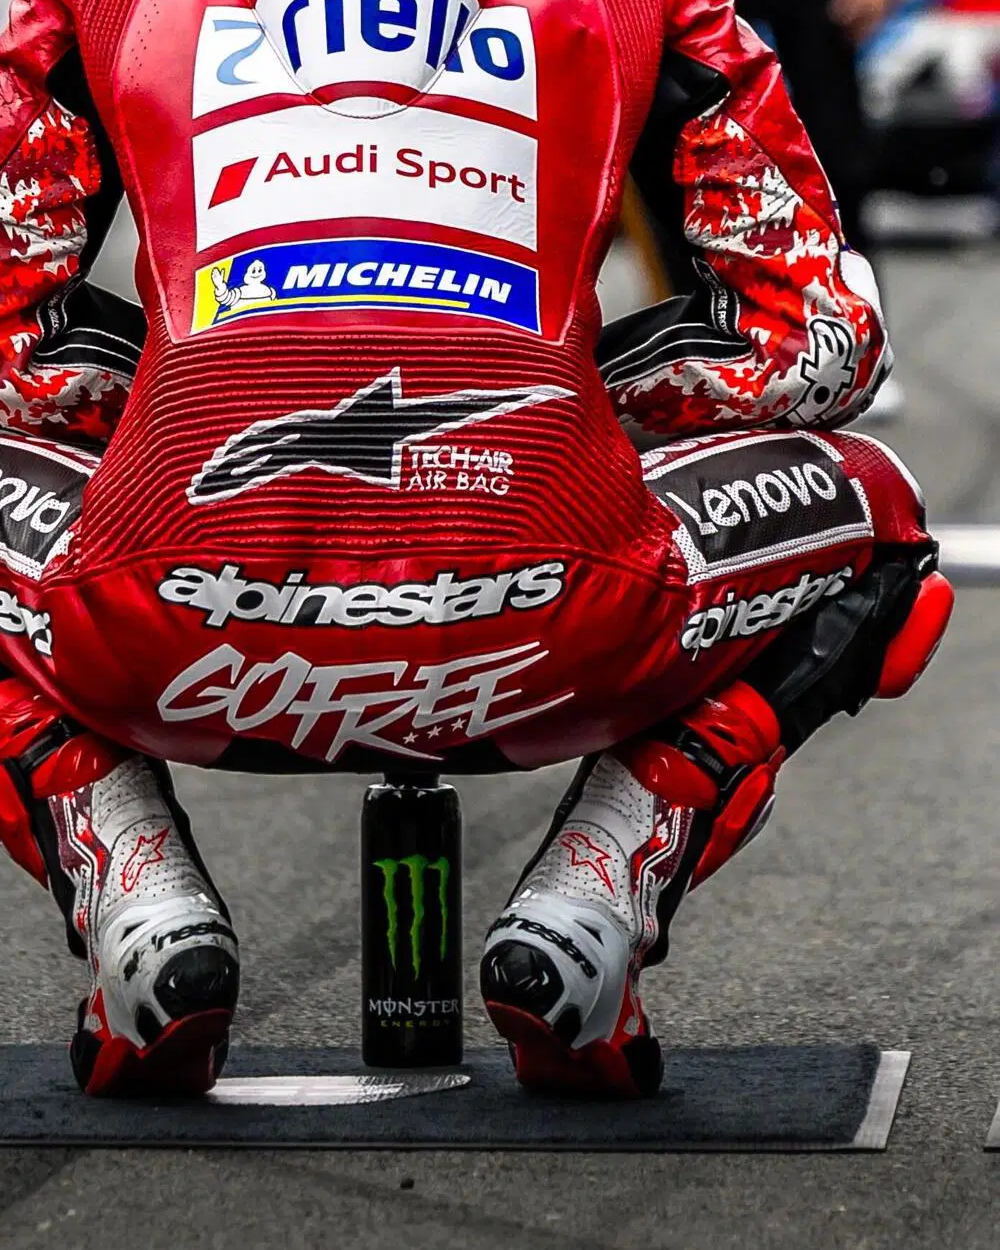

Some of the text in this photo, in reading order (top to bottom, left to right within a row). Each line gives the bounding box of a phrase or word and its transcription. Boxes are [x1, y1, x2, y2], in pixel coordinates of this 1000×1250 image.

[264, 144, 526, 203] Audi Sport
[283, 261, 513, 303] MICHELIN
[405, 470, 510, 496] AIR BAG
[666, 461, 837, 537] Lenovo
[158, 561, 565, 627] alpinestars
[680, 566, 853, 661] apinestars
[368, 997, 460, 1017] MONSTER
